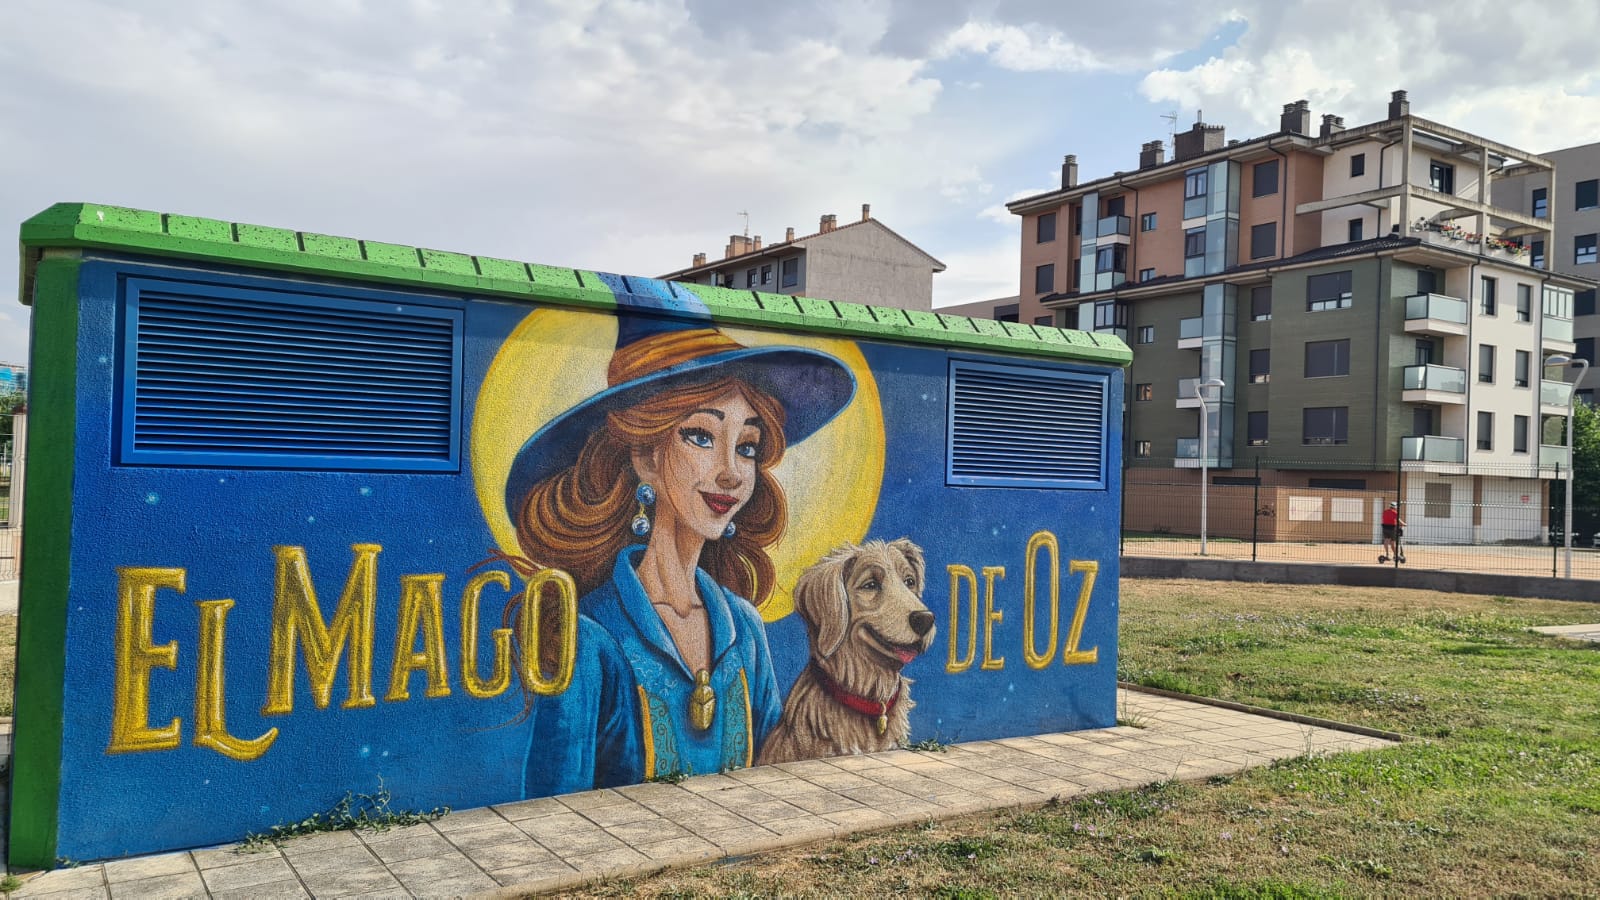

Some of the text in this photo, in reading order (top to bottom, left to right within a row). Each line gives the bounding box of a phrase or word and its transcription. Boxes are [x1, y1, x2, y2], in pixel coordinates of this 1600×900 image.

[106, 530, 1099, 761] EL MAGO DE OZ
